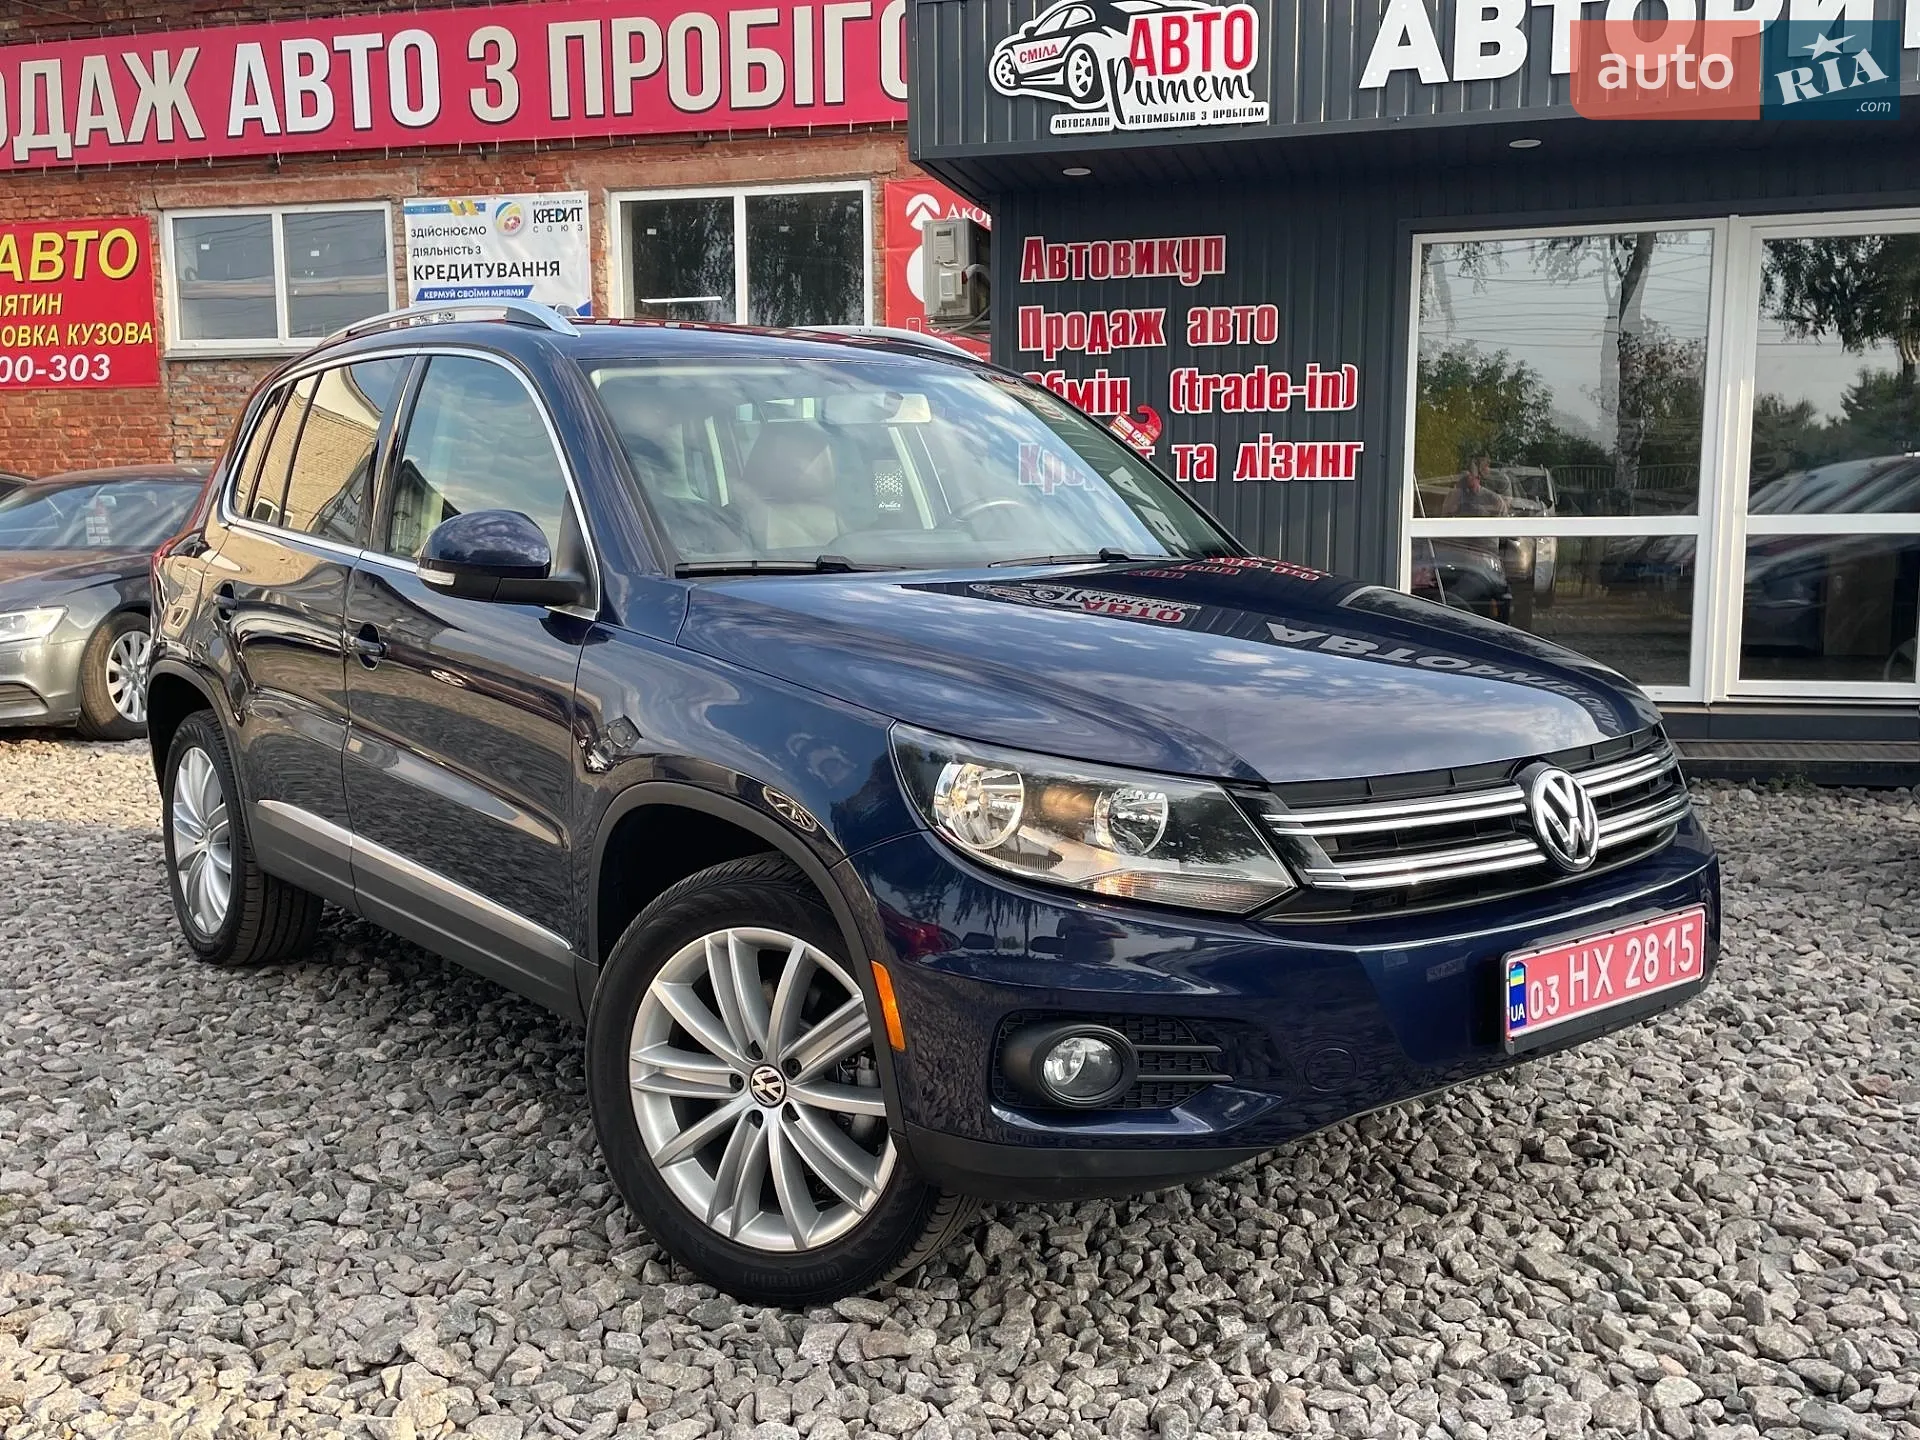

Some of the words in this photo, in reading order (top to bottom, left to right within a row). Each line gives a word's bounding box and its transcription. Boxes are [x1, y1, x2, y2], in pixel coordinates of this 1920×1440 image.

[1018, 44, 1059, 64] СМІЛА
[1130, 10, 1253, 77] АВТО
[0, 47, 205, 161] ДАЖ
[228, 29, 441, 137] АВТО
[469, 26, 519, 123] З
[1054, 117, 1110, 129] АВТОСАЛОН
[1128, 111, 1196, 125] АВТОМОБІЛІВ
[1213, 107, 1265, 120] ПРОБІГОМ
[411, 226, 487, 238] ЗДІЙСНЮЄМО
[0, 228, 138, 282] АВТО
[412, 247, 473, 258] ДІЯЛЬНІСТЬ
[1019, 235, 1227, 286] Автовикуп
[413, 260, 561, 282] КРЕДИТУВАННЯ
[0, 293, 63, 317] ЯТИН
[424, 289, 456, 299] КЕРМУЙ
[457, 288, 490, 298] СВОЇМИ
[491, 288, 525, 297] МРІЯМИ
[67, 322, 153, 346] КУЗОВА
[1018, 305, 1167, 361] Продаж
[1187, 304, 1279, 346] авто
[1170, 363, 1358, 413] (trade-in)
[1171, 443, 1217, 482] та
[1233, 433, 1364, 482] лізинг
[1529, 974, 1560, 1020] 03
[1568, 943, 1614, 1006] HX
[1625, 922, 1695, 990] 2815
[1510, 1003, 1526, 1022] UA
